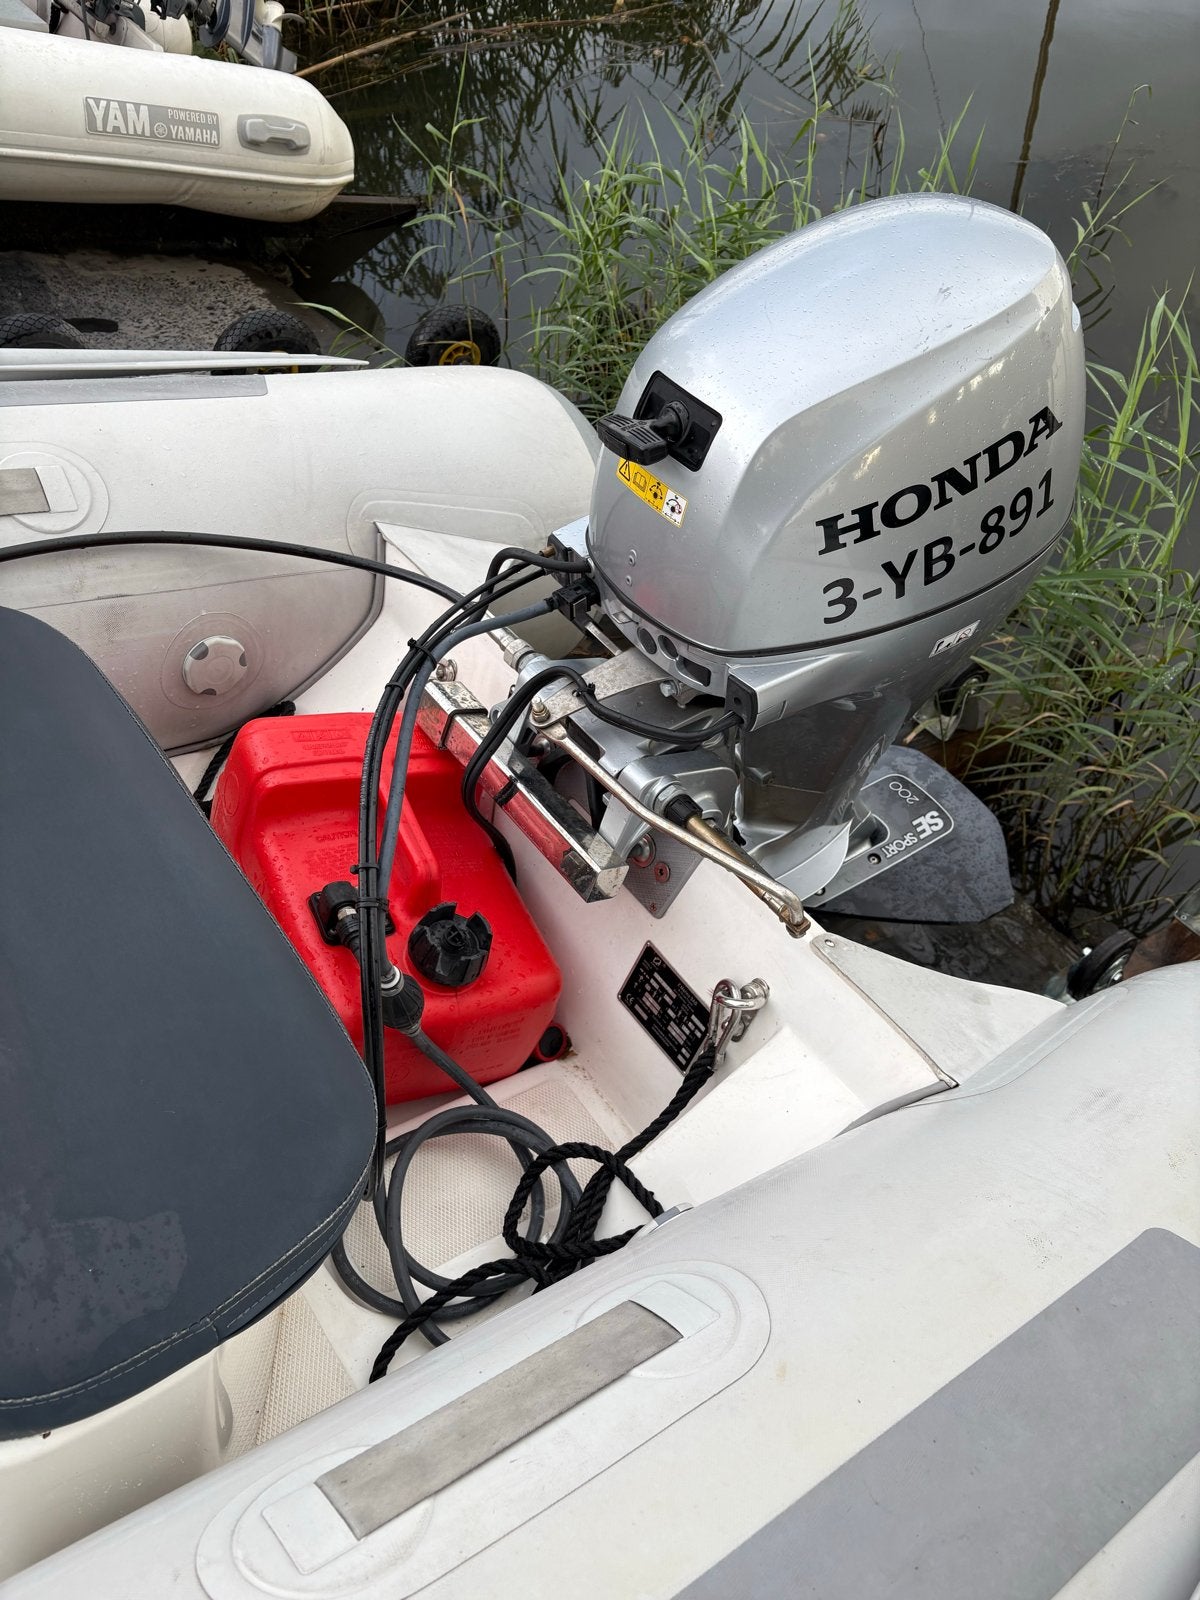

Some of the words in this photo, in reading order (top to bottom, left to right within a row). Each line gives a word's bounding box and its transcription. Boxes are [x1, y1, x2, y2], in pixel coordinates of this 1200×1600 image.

[86, 98, 150, 137] YAM
[167, 108, 206, 123] POWERED
[207, 114, 217, 125] BY
[169, 124, 218, 145] YAMAHA
[815, 406, 1063, 556] HONDA
[823, 467, 1055, 625] 3-YB-891
[889, 781, 920, 805] 200
[912, 810, 944, 840] SE
[882, 832, 918, 859] SPORT
